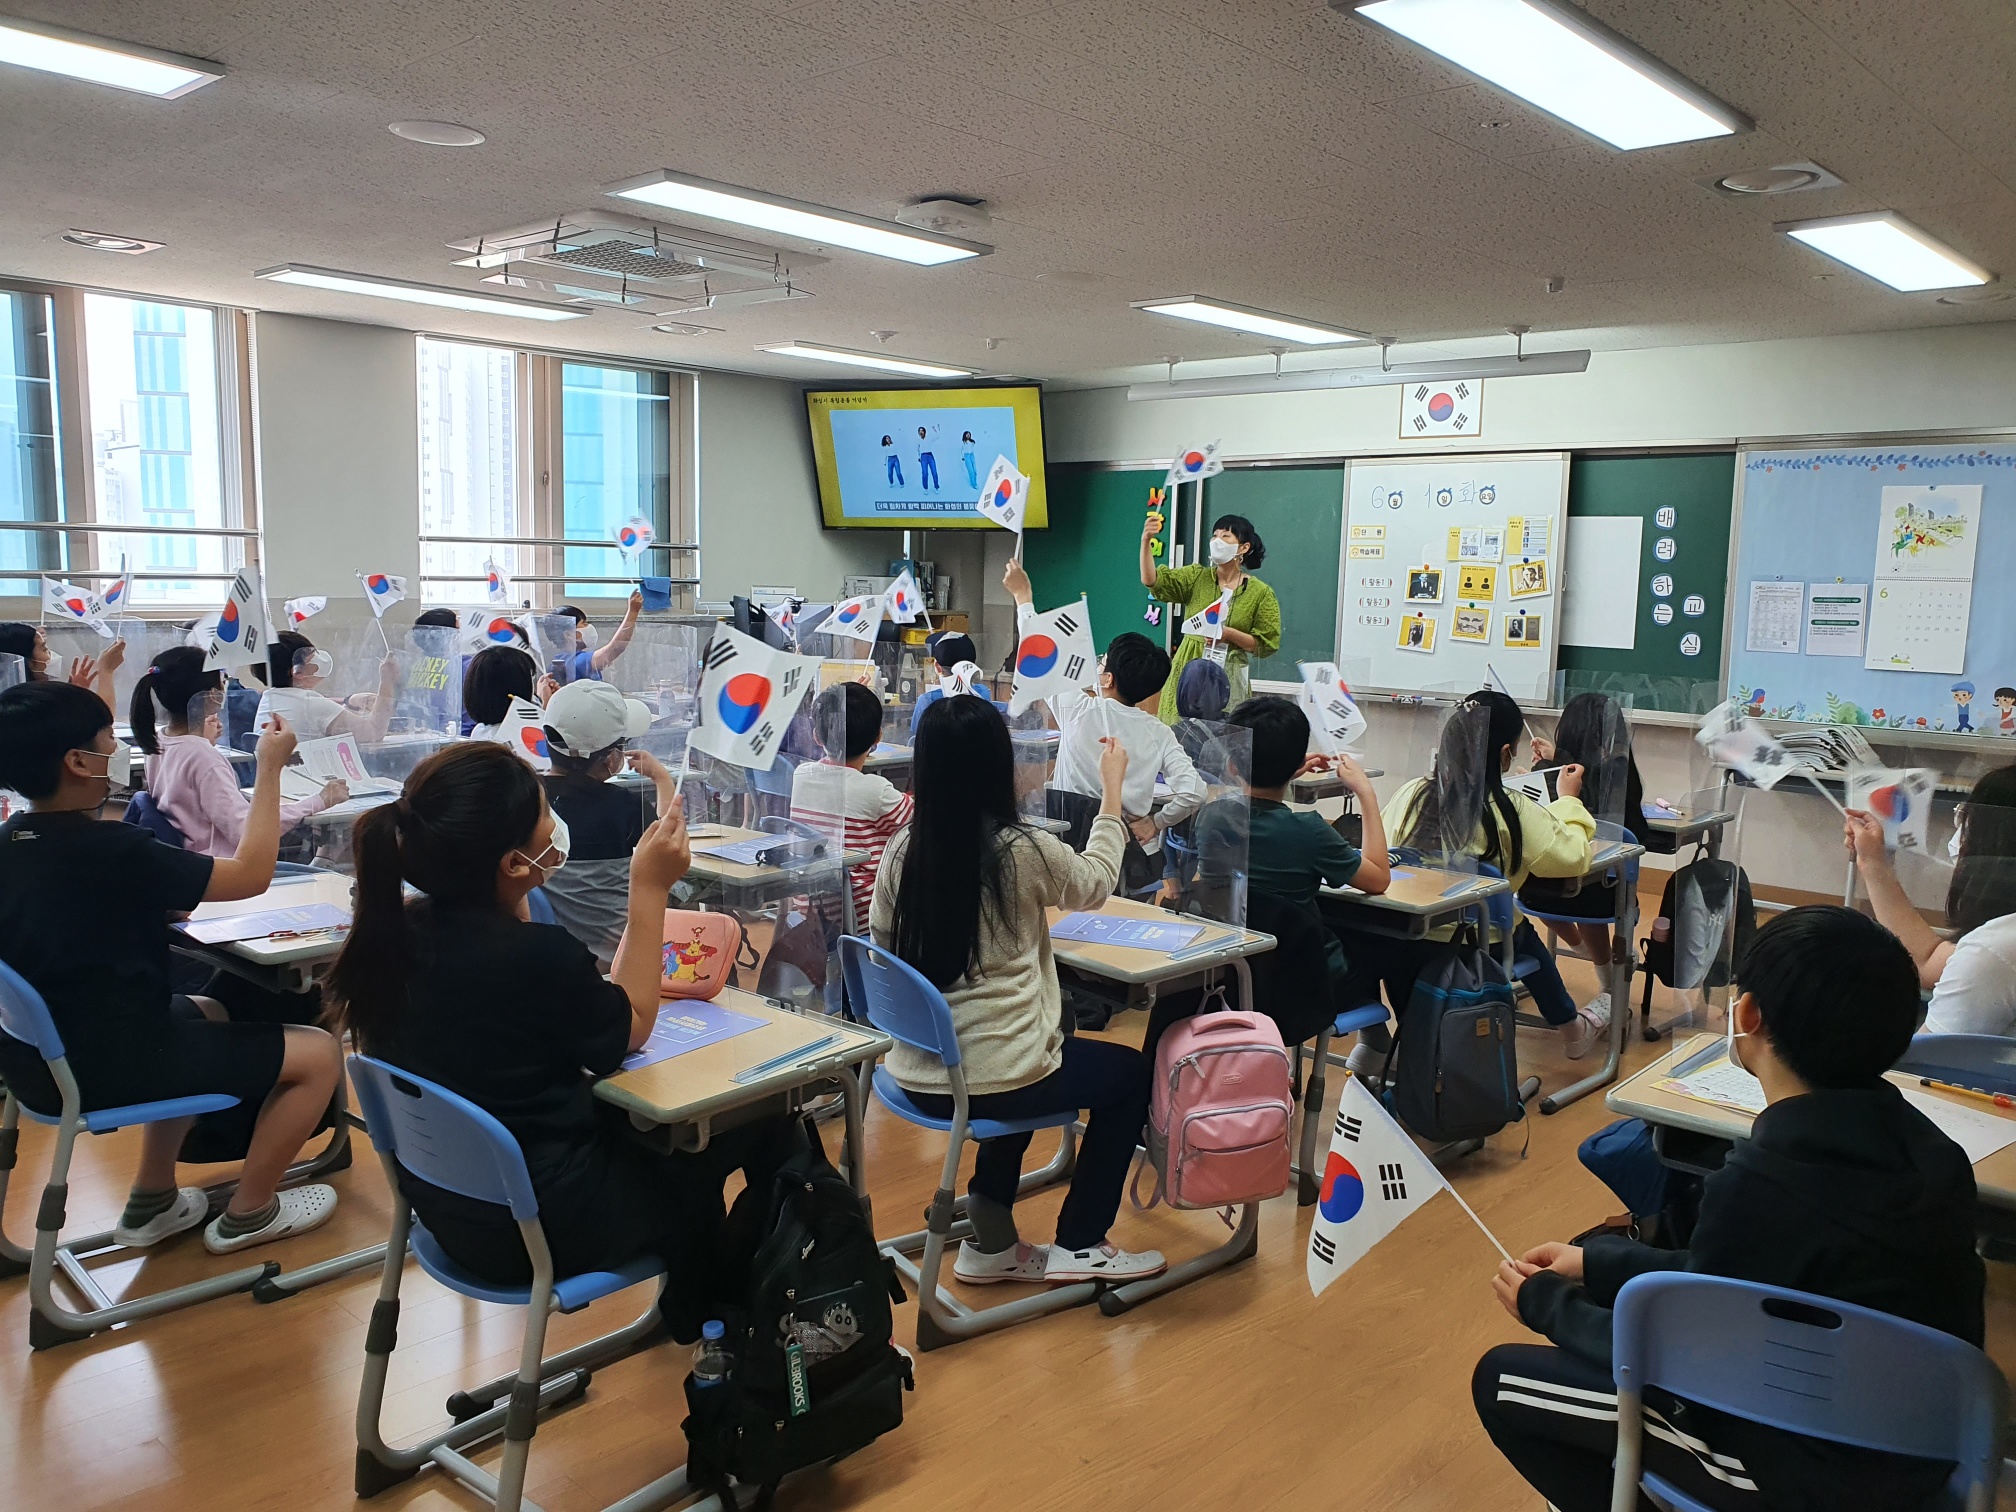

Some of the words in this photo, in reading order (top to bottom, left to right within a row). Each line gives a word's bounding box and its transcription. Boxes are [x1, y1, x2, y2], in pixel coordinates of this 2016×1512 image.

[1359, 548, 1381, 556] 학습목표
[1653, 508, 1674, 623] 배려하는
[1879, 587, 1889, 599] 6
[1681, 598, 1703, 654] 교실
[790, 1351, 806, 1407] GILBROOKS
